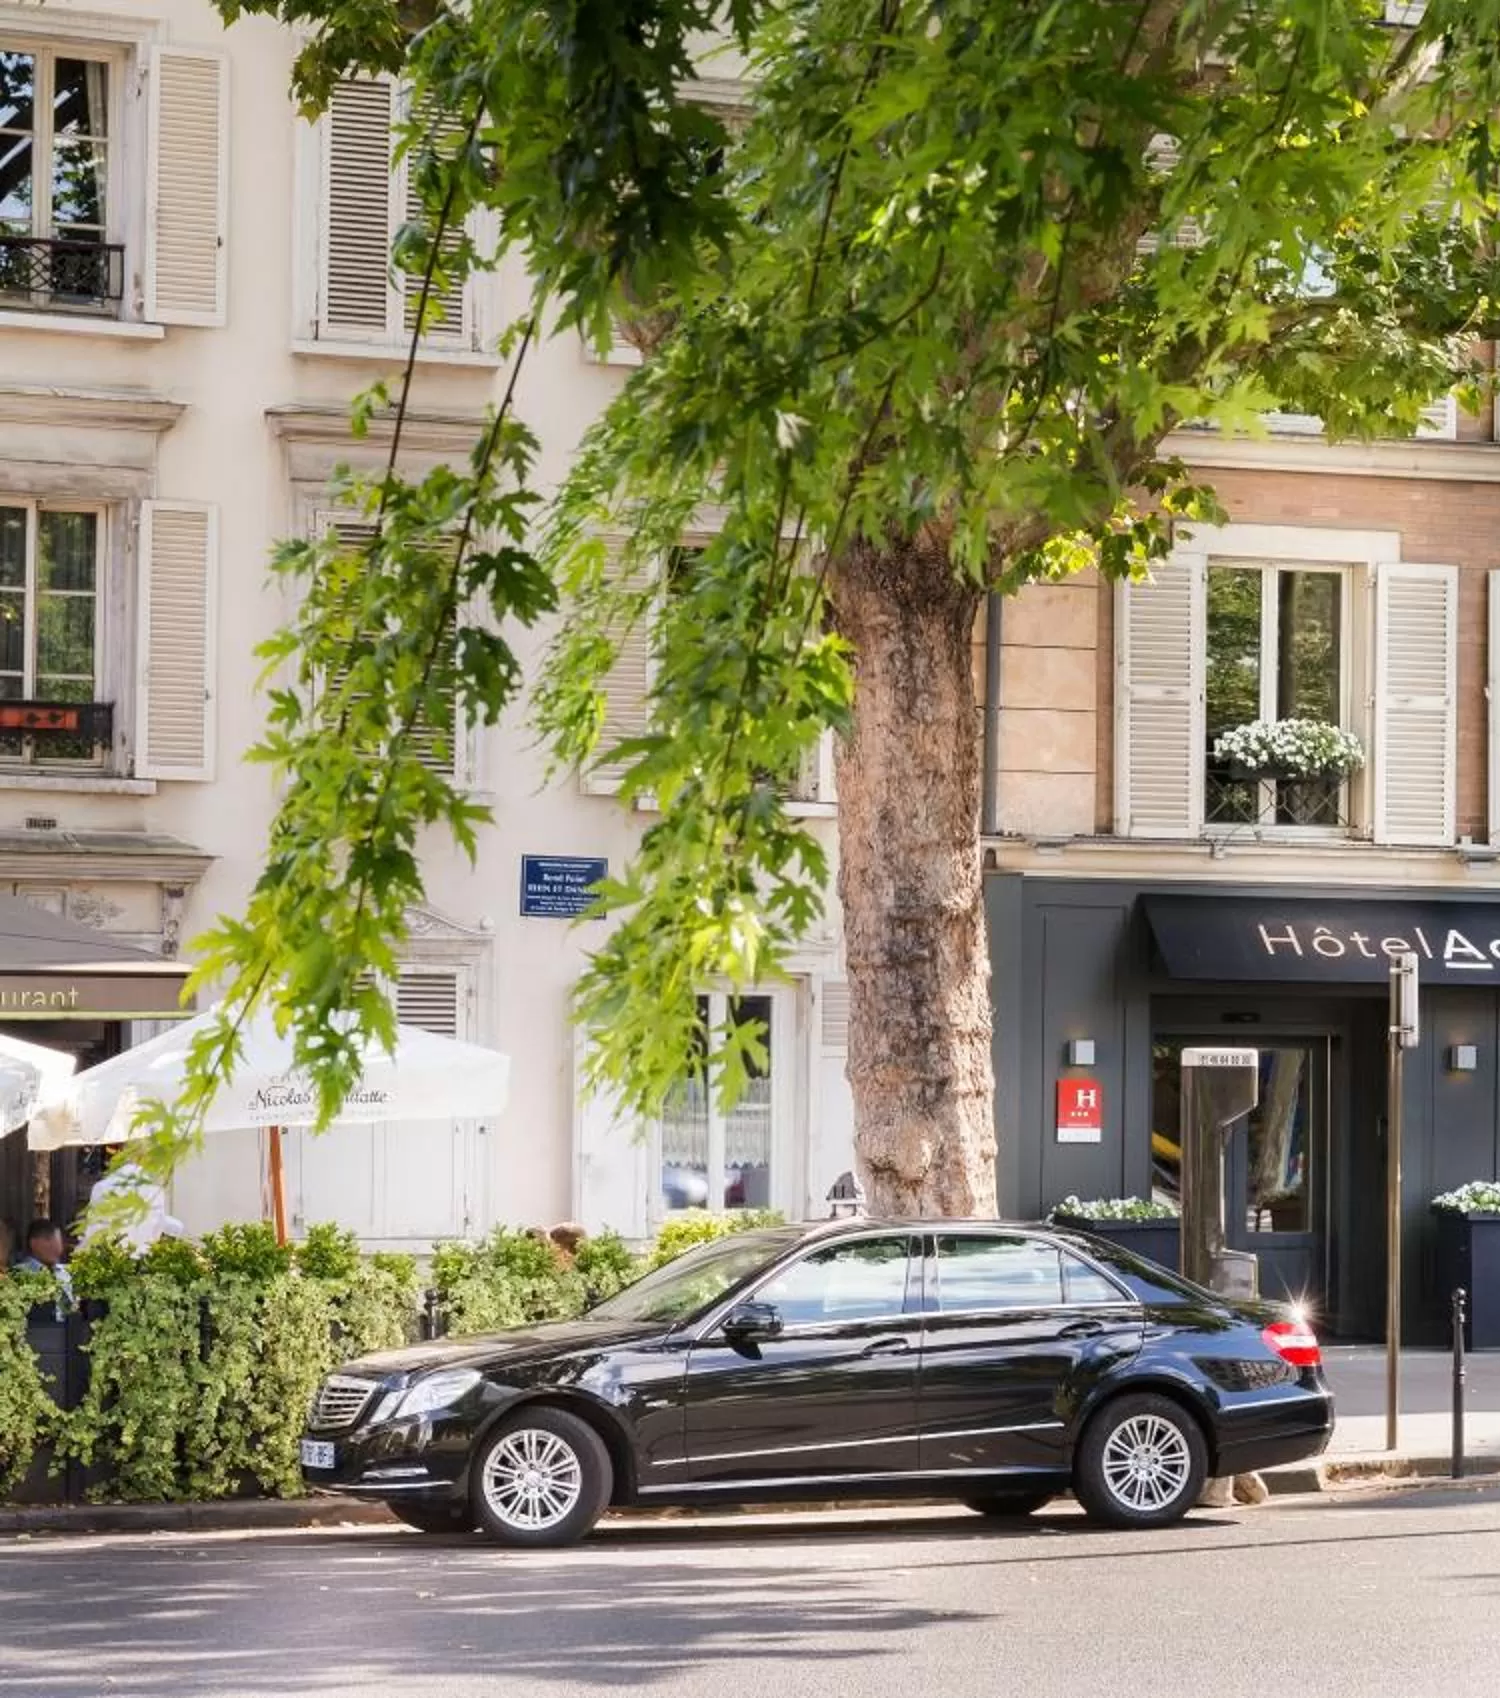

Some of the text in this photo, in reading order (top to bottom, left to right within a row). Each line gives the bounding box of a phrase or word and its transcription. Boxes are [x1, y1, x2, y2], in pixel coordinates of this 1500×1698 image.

[1257, 923, 1434, 959] Hôtel
[249, 1088, 311, 1109] Nicolas
[1076, 1089, 1097, 1108] H
